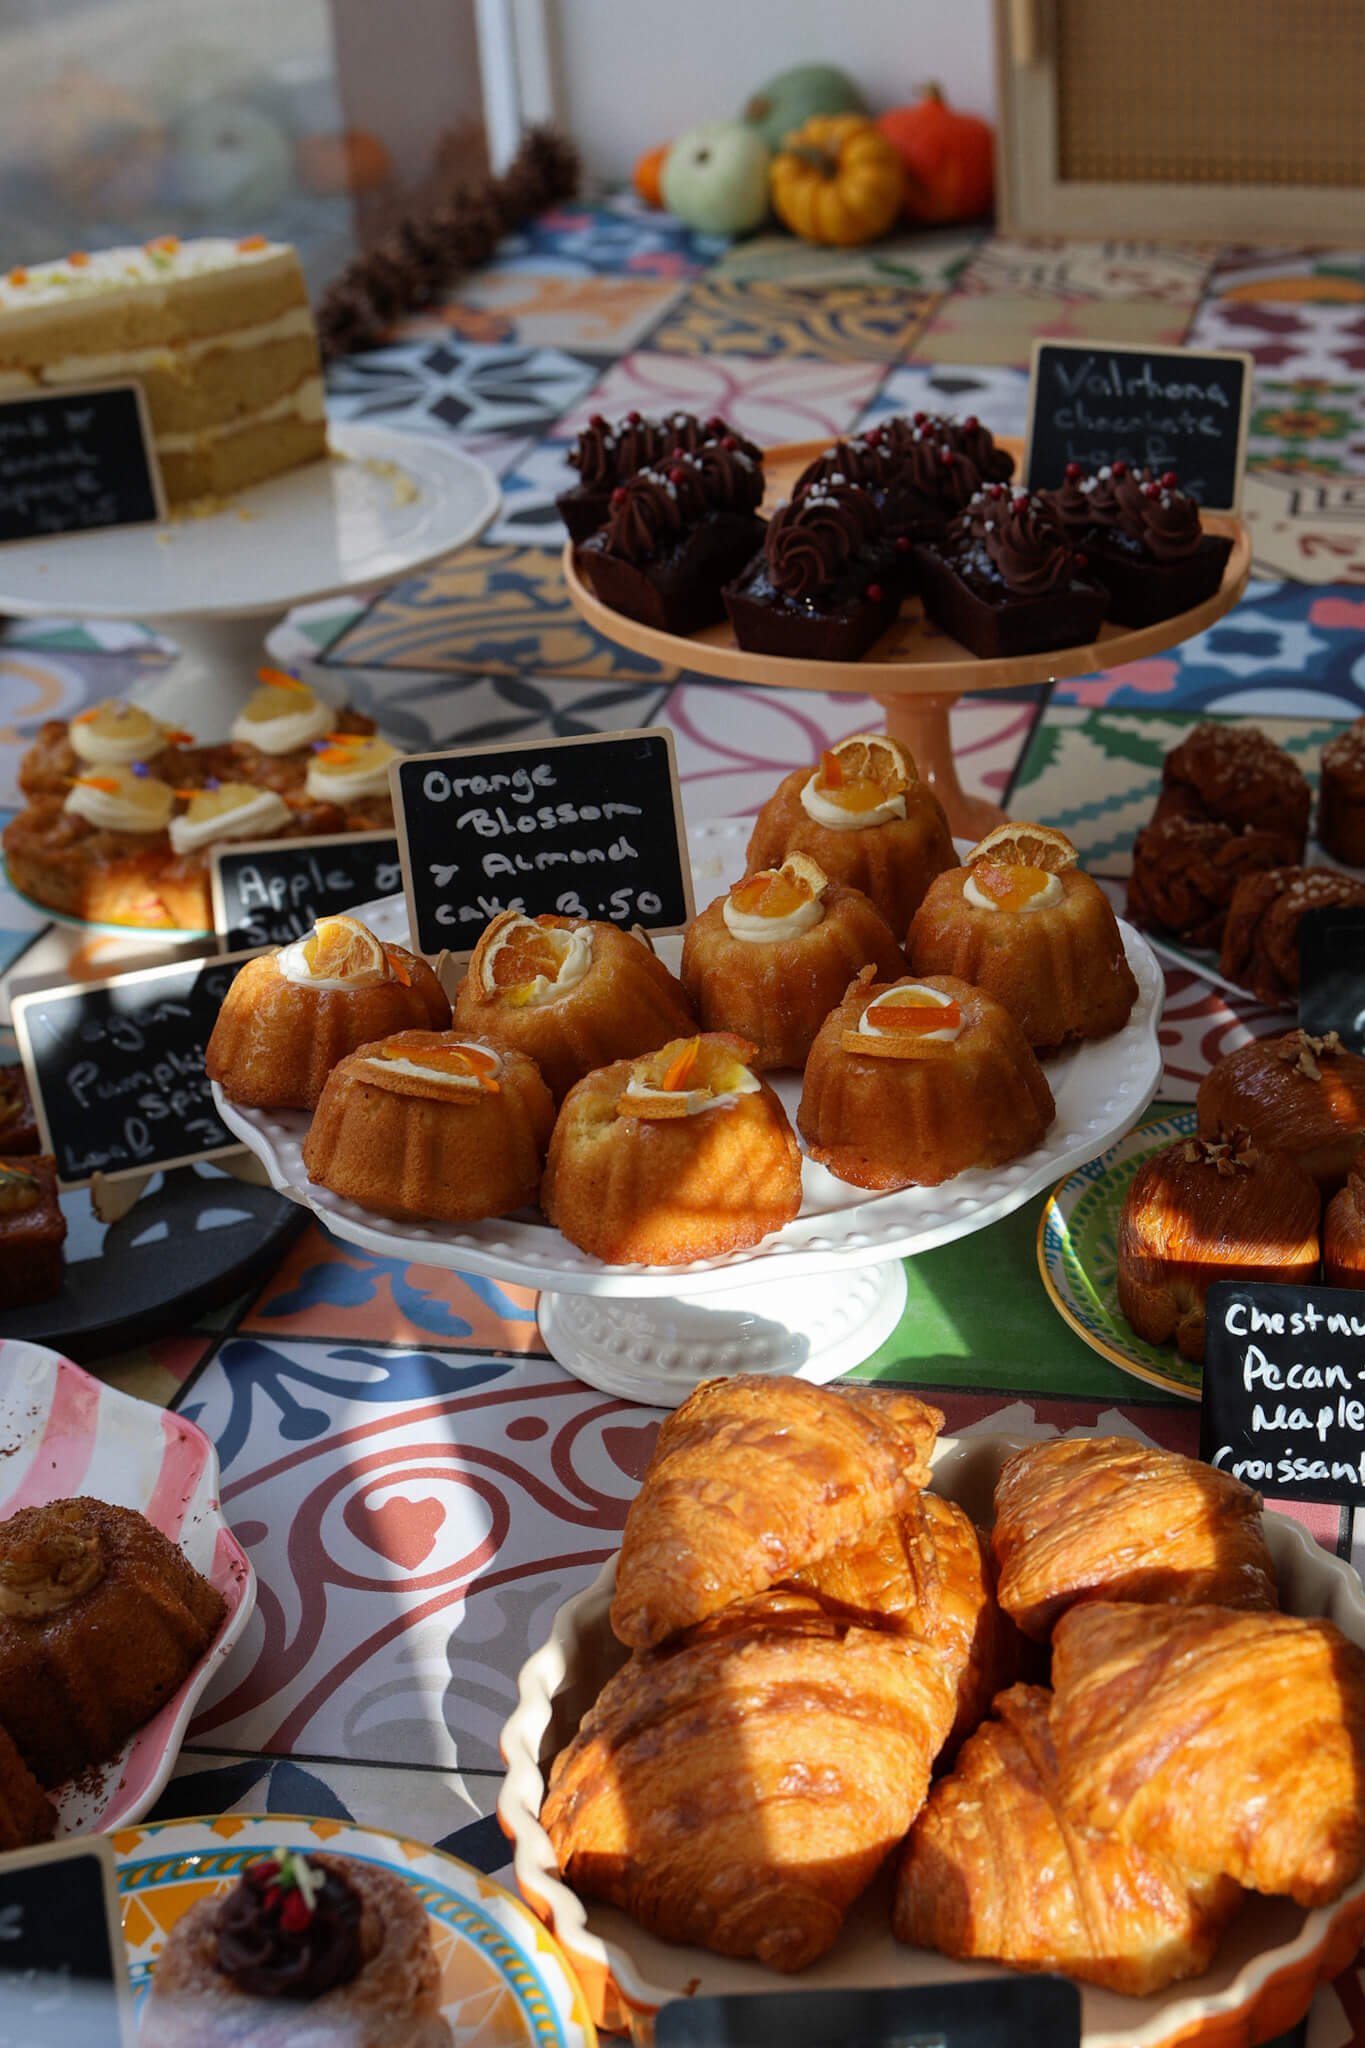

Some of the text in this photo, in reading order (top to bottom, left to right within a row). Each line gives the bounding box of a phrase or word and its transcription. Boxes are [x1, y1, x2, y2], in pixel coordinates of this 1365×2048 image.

[423, 764, 558, 804] Orange
[456, 802, 643, 838] Blossom
[481, 836, 639, 879] Almond
[237, 856, 355, 914] Apple
[555, 888, 663, 921] 3.50
[66, 1043, 208, 1109] Pumpki
[1224, 1303, 1365, 1337] Chestnu
[1242, 1344, 1353, 1393] Pecan
[1251, 1395, 1365, 1443] Maple
